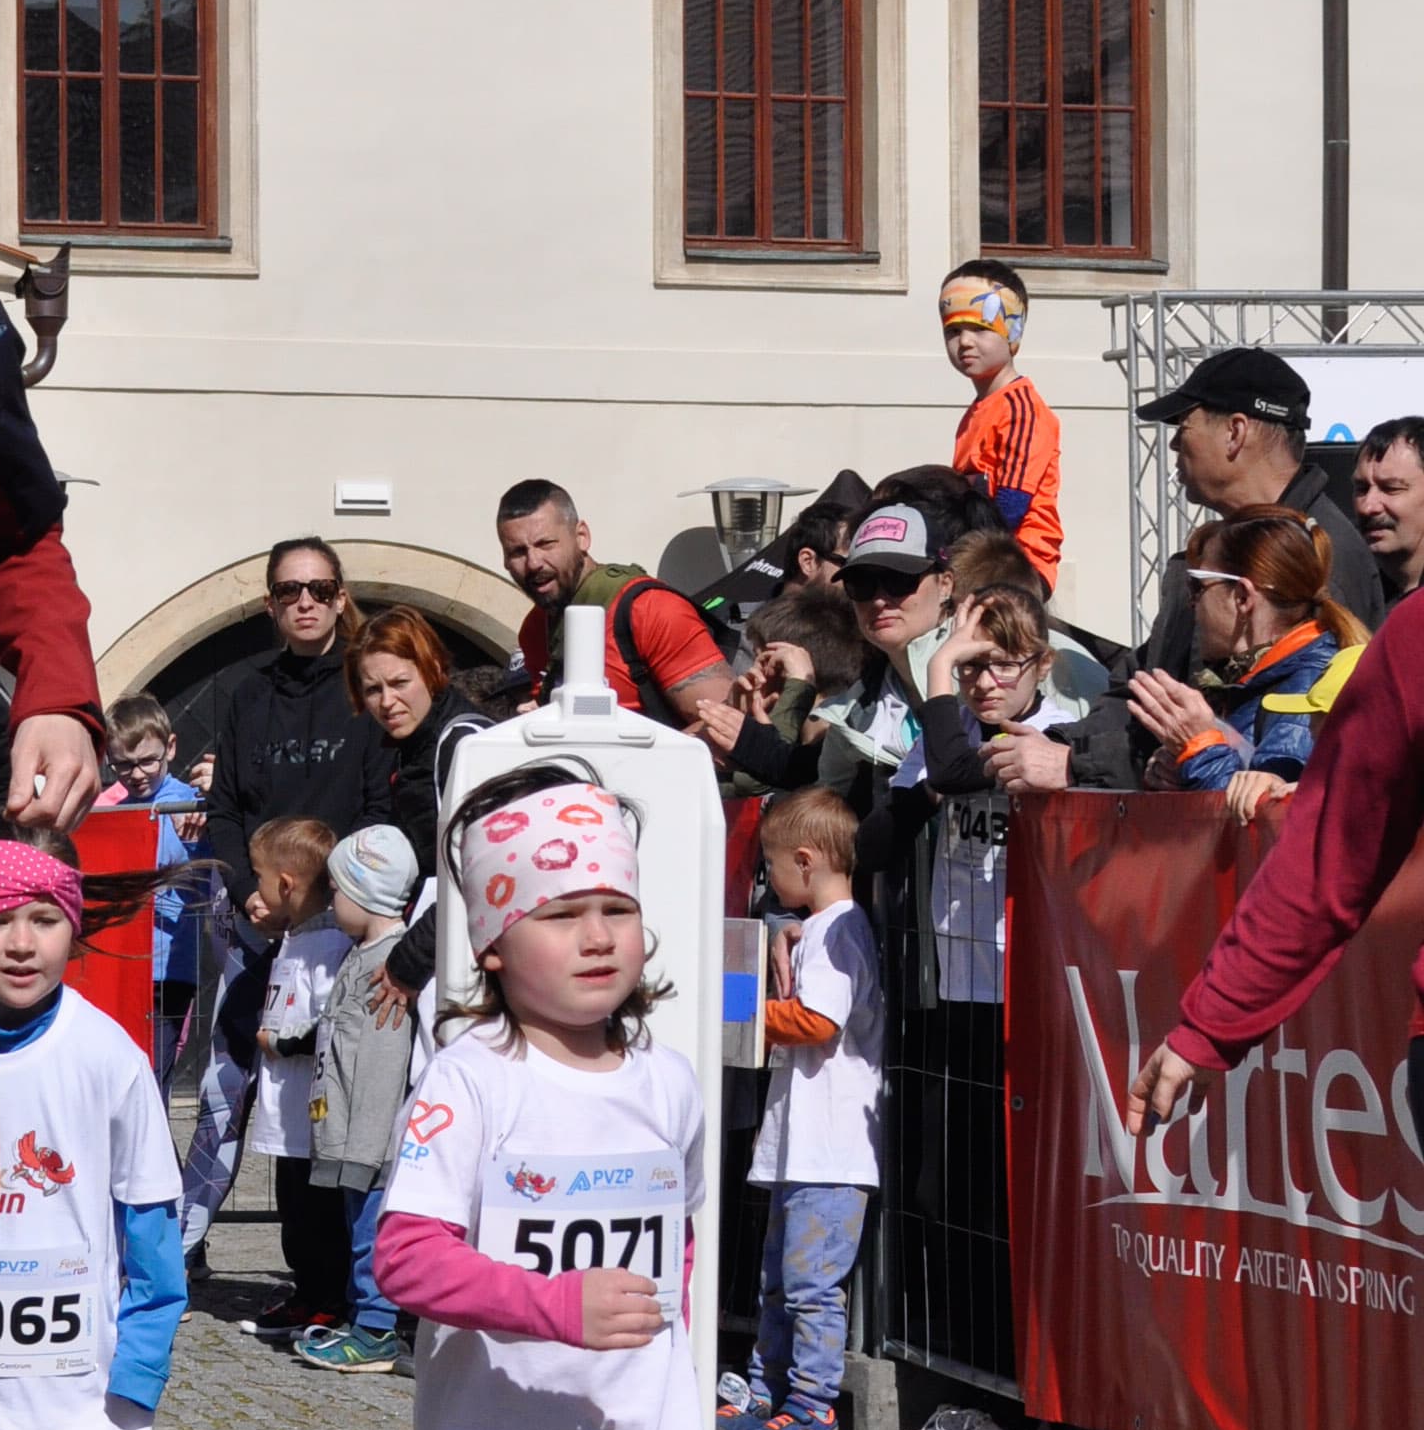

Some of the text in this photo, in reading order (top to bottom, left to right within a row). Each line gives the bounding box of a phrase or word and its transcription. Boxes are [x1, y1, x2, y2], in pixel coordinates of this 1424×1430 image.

[400, 1141, 430, 1161] ZP
[593, 1168, 635, 1185] PVZP
[514, 1215, 663, 1279] 5071
[1134, 1232, 1226, 1281] QUALITY
[1335, 1264, 1416, 1316] SPRING
